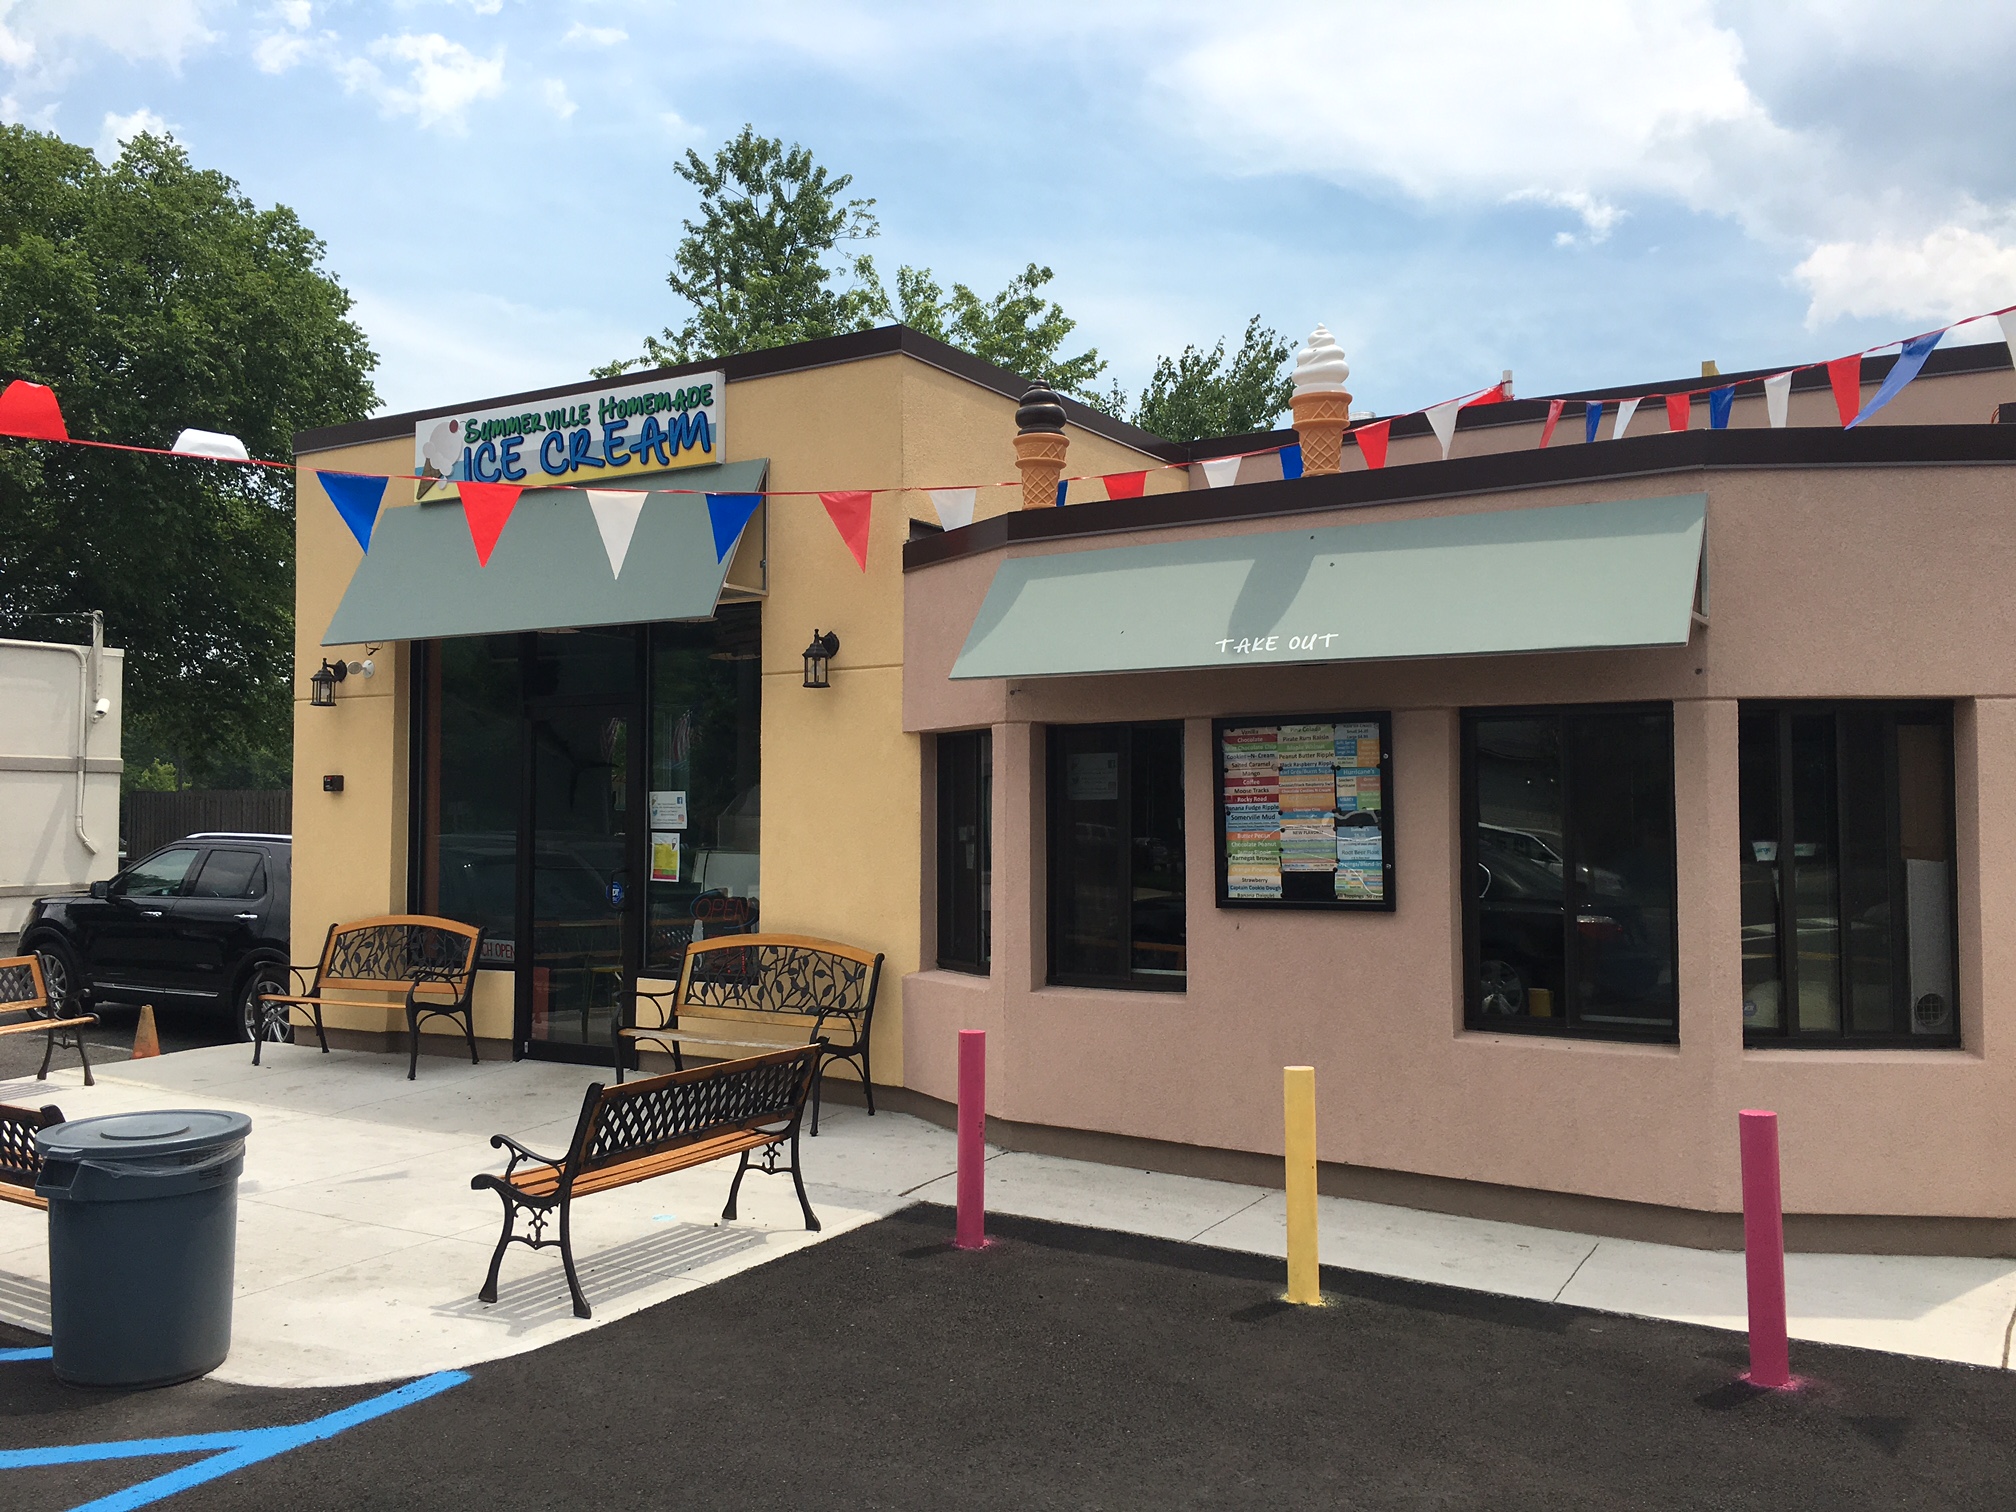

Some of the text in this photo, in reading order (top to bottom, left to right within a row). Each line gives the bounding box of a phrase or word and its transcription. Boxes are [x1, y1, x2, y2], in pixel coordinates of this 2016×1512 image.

[598, 384, 714, 427] HOMEMADE
[464, 411, 712, 483] ICE CREAM
[1215, 633, 1340, 654] TAKE OUT
[696, 898, 751, 921] OPEN
